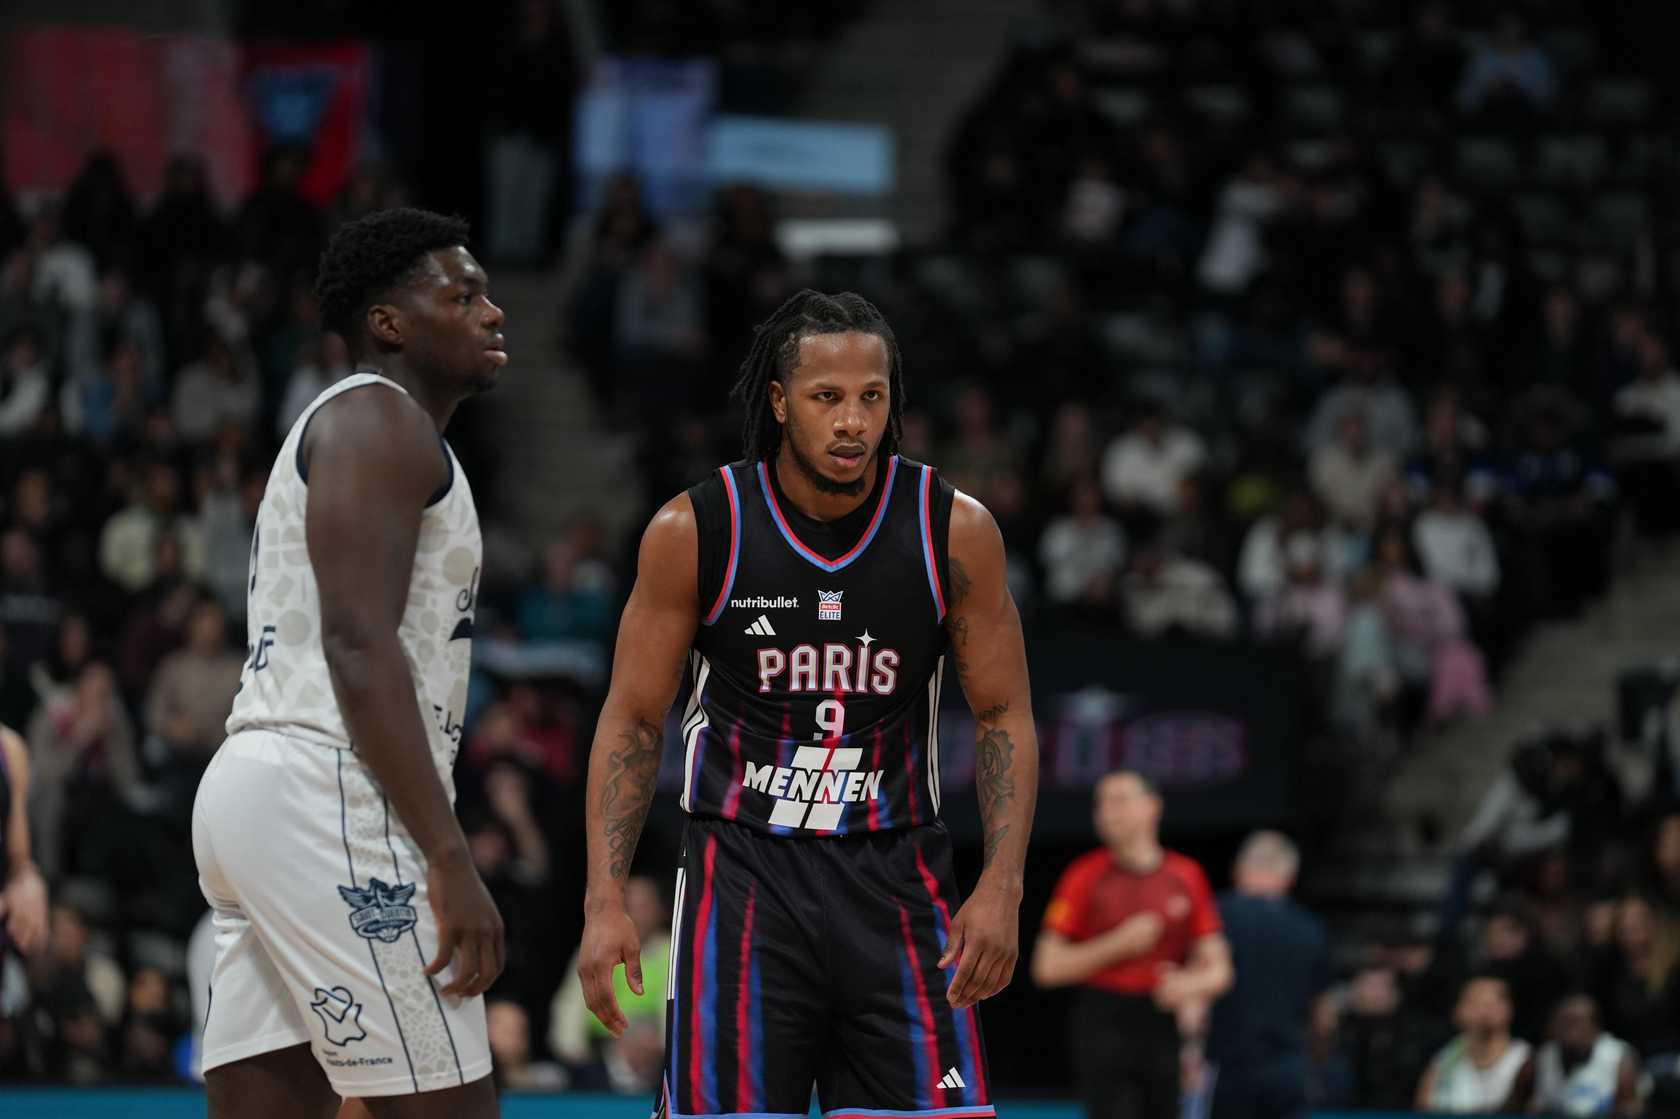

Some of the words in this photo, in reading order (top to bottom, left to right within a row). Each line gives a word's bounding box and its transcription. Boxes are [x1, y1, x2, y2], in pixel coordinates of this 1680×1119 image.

[757, 643, 900, 695] PARIS
[813, 699, 845, 743] 9
[742, 761, 885, 804] MENNEN
